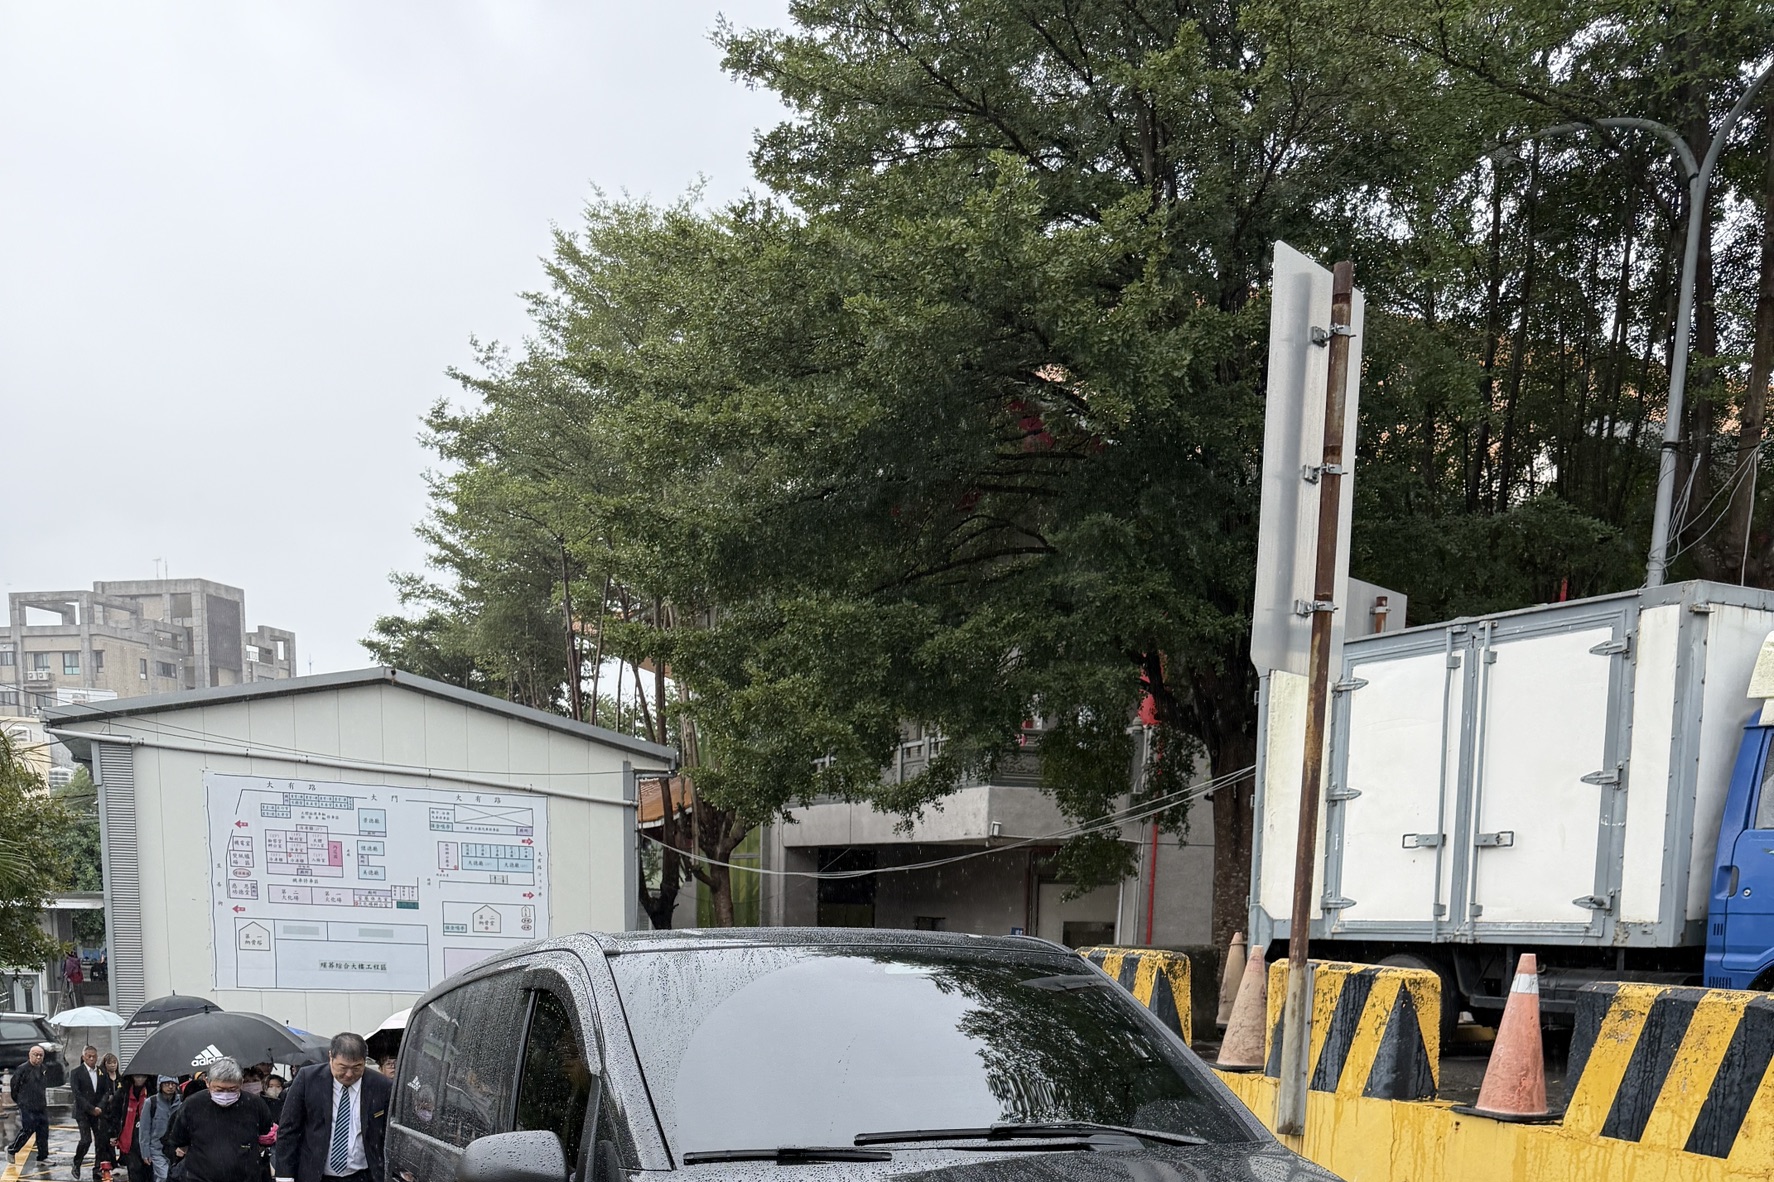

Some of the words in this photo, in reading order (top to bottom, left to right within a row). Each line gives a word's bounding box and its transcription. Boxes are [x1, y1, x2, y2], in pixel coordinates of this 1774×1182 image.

[267, 781, 316, 791] 大有路
[371, 794, 398, 803] 大門
[456, 794, 501, 804] 大有路
[320, 962, 387, 971] 殯葬綜合大樓工程區
